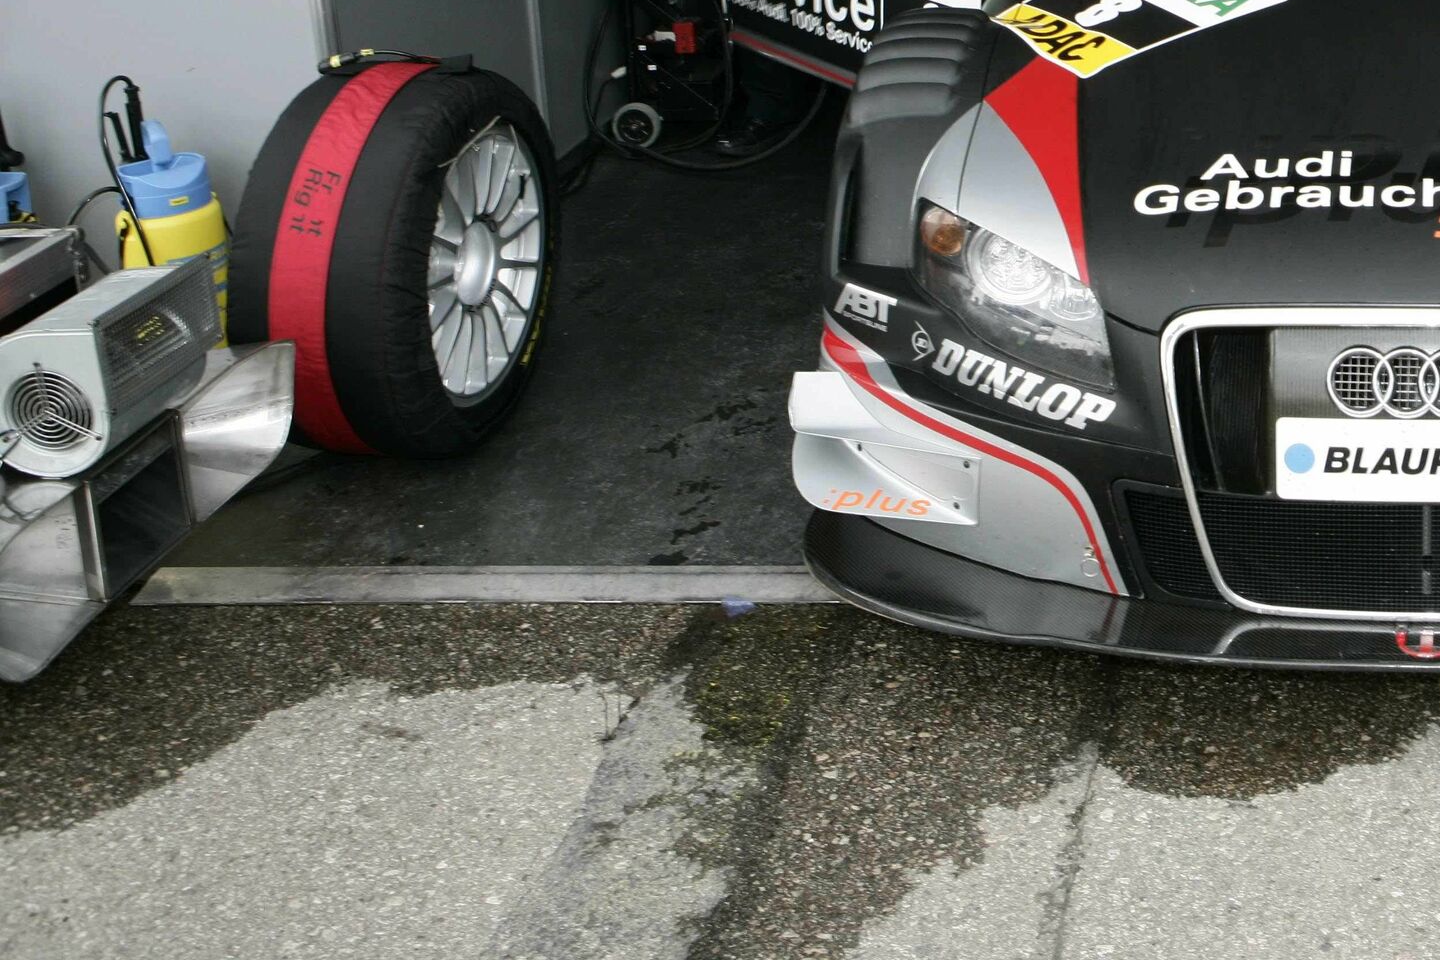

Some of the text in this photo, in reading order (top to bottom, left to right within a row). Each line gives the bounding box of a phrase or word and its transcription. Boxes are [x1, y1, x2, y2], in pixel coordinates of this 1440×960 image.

[1199, 150, 1354, 181] Audi
[834, 283, 898, 323] ABT
[931, 337, 1117, 431] DUNLOP
[823, 488, 932, 516] :plus
